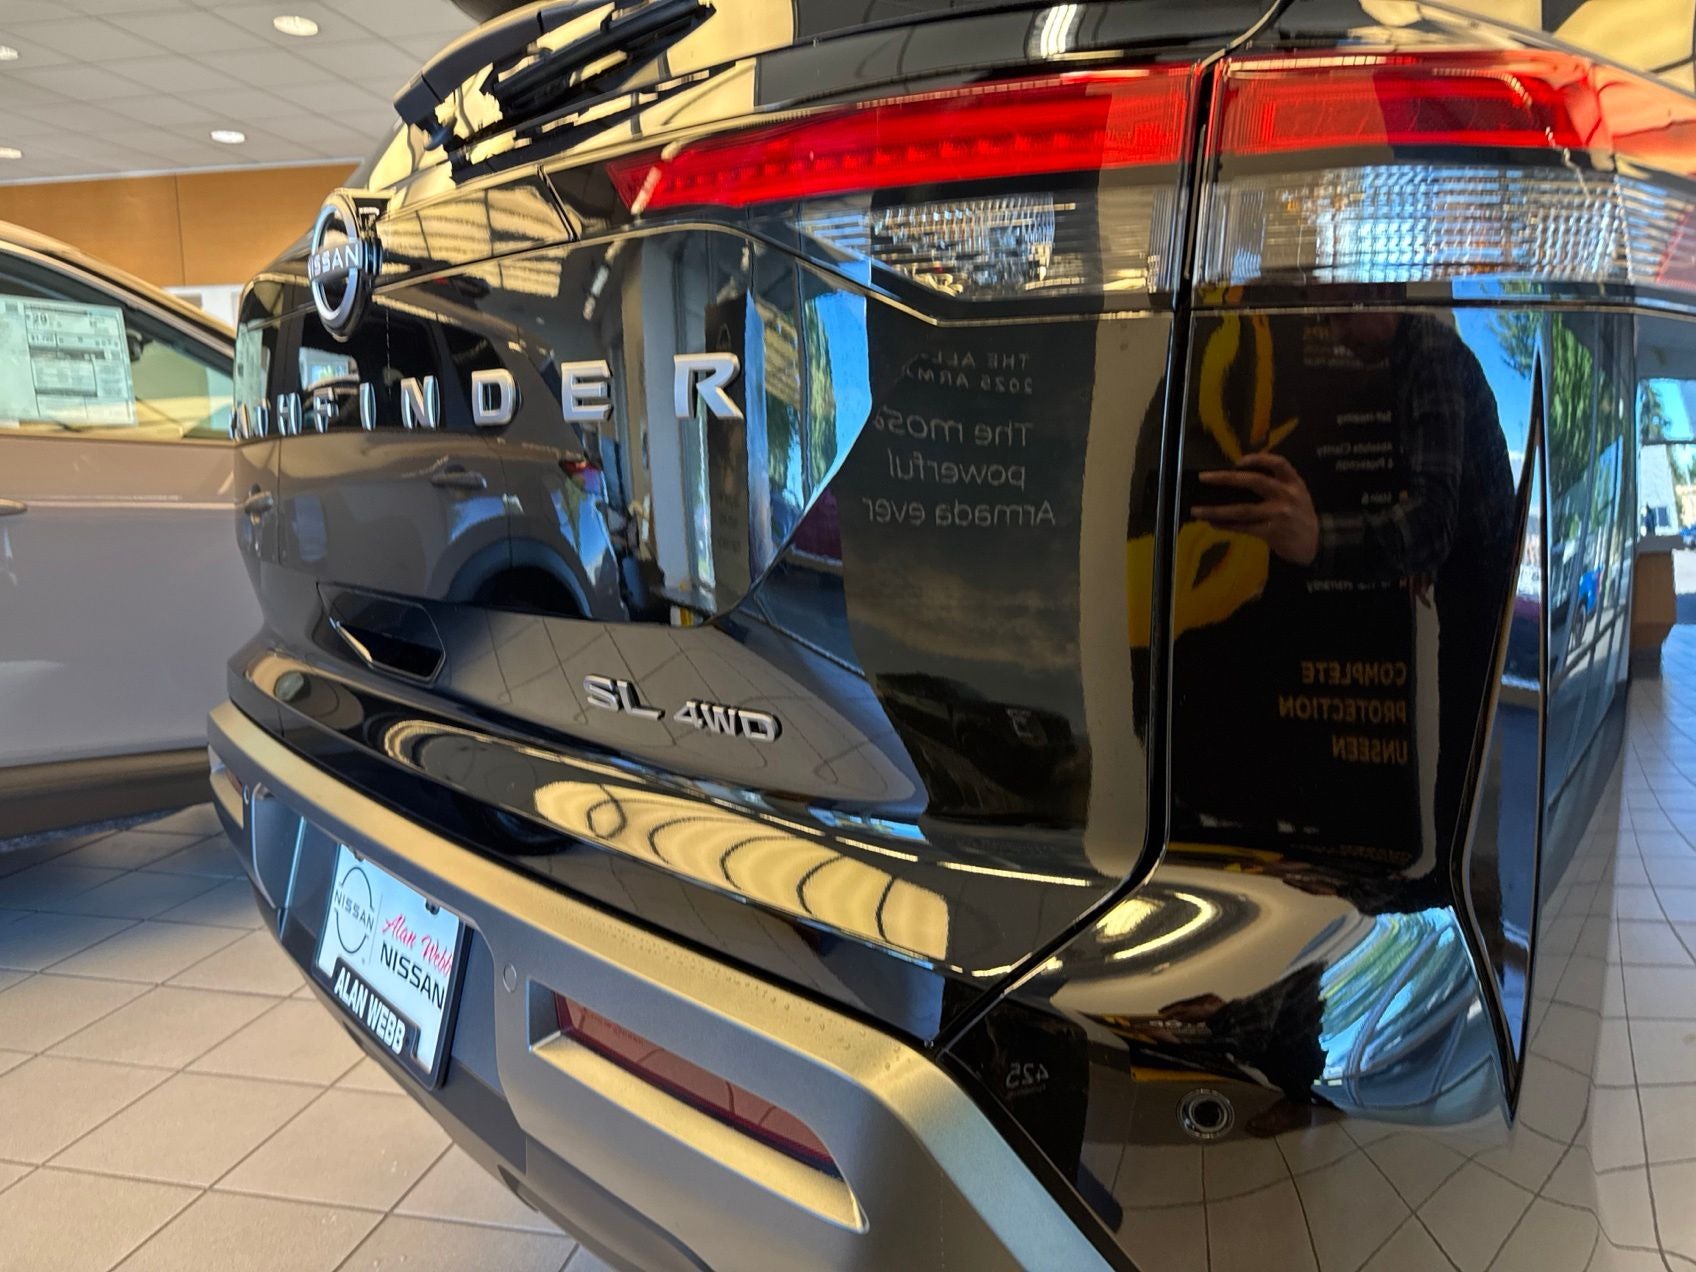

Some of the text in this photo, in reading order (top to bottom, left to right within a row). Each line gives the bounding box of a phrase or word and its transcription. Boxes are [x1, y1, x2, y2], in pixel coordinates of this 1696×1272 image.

[583, 674, 783, 743] SL 4WD
[334, 888, 375, 932] NISSAN
[382, 912, 453, 977] Alan Webb
[380, 939, 446, 1010] NISSAN
[334, 967, 406, 1055] ALAN WEBB
